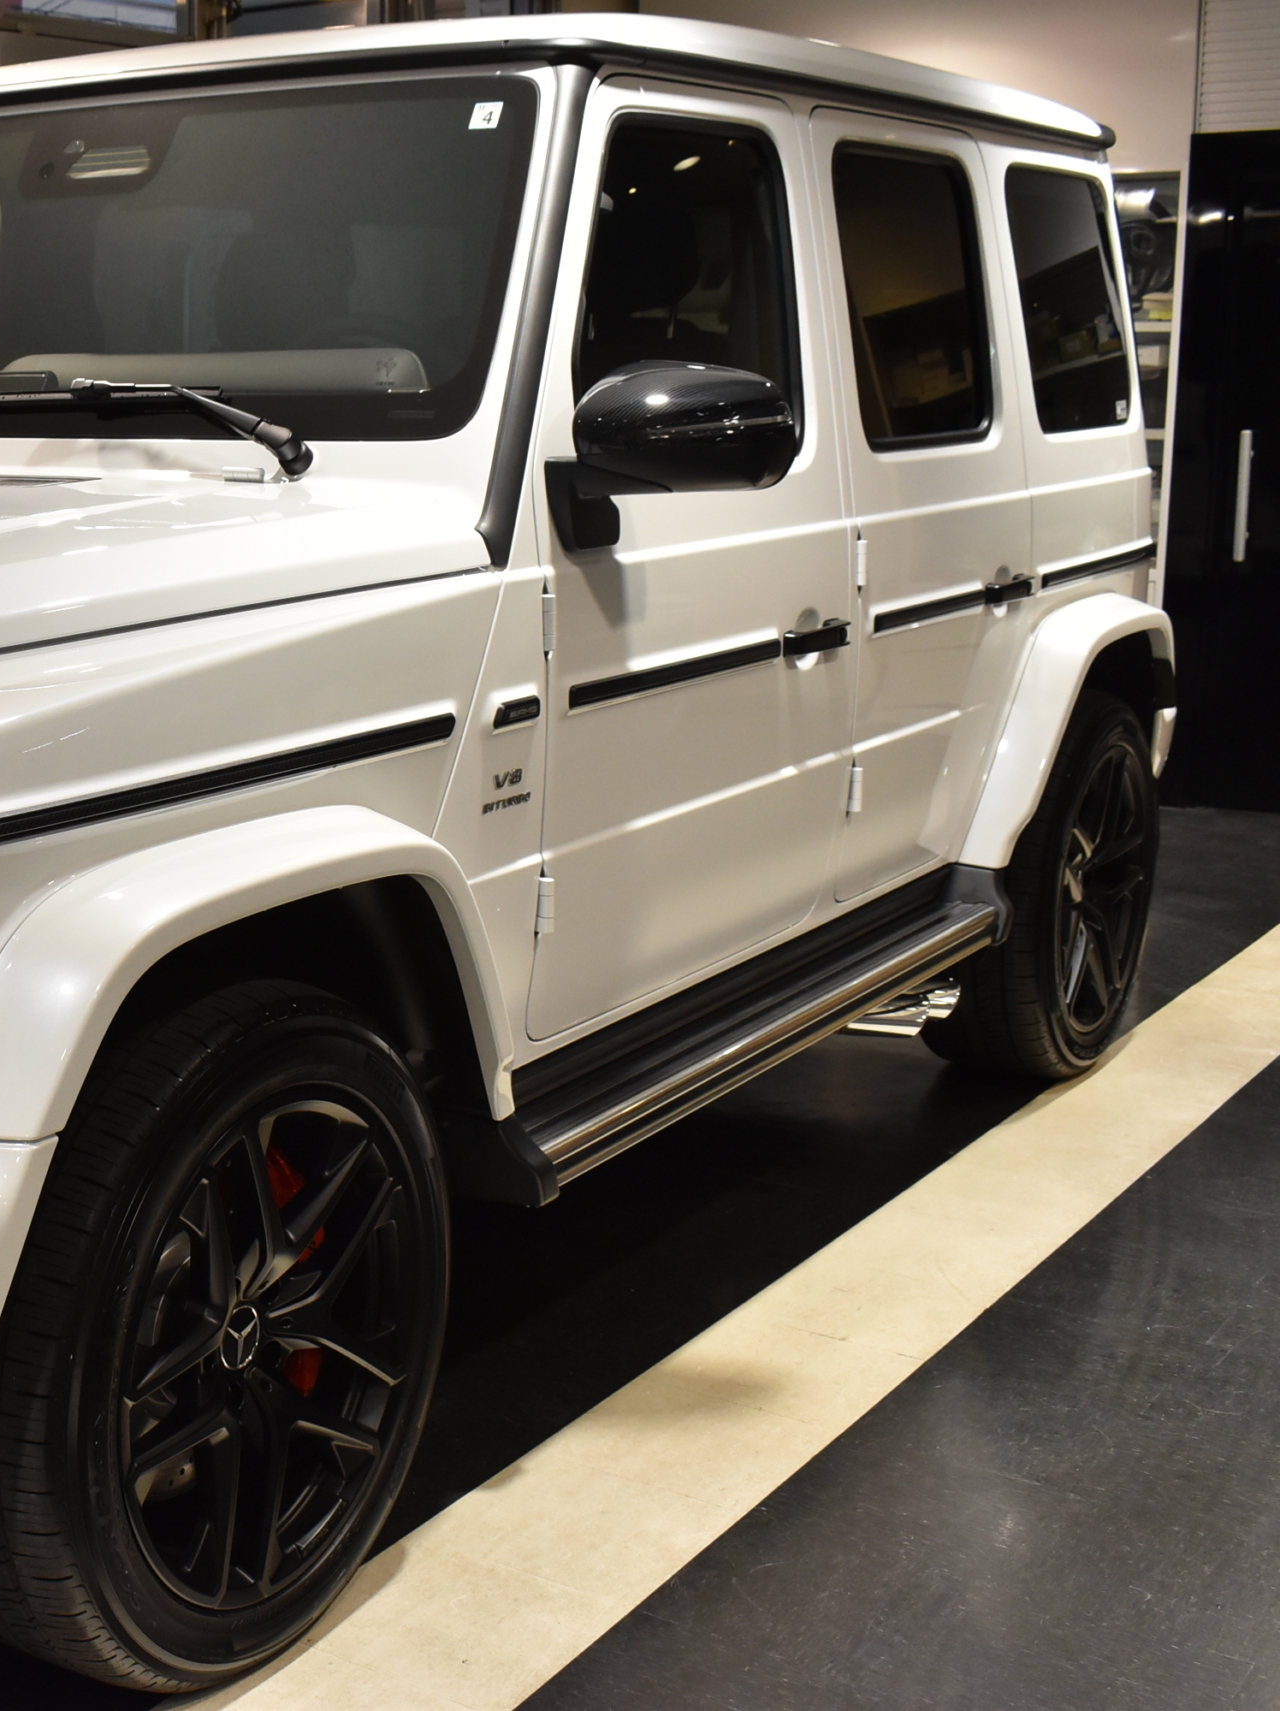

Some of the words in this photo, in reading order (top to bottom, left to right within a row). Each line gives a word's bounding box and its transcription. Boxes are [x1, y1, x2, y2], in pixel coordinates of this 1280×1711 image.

[482, 110, 494, 125] 4
[493, 768, 522, 790] V8
[482, 792, 531, 815] BITURBO
